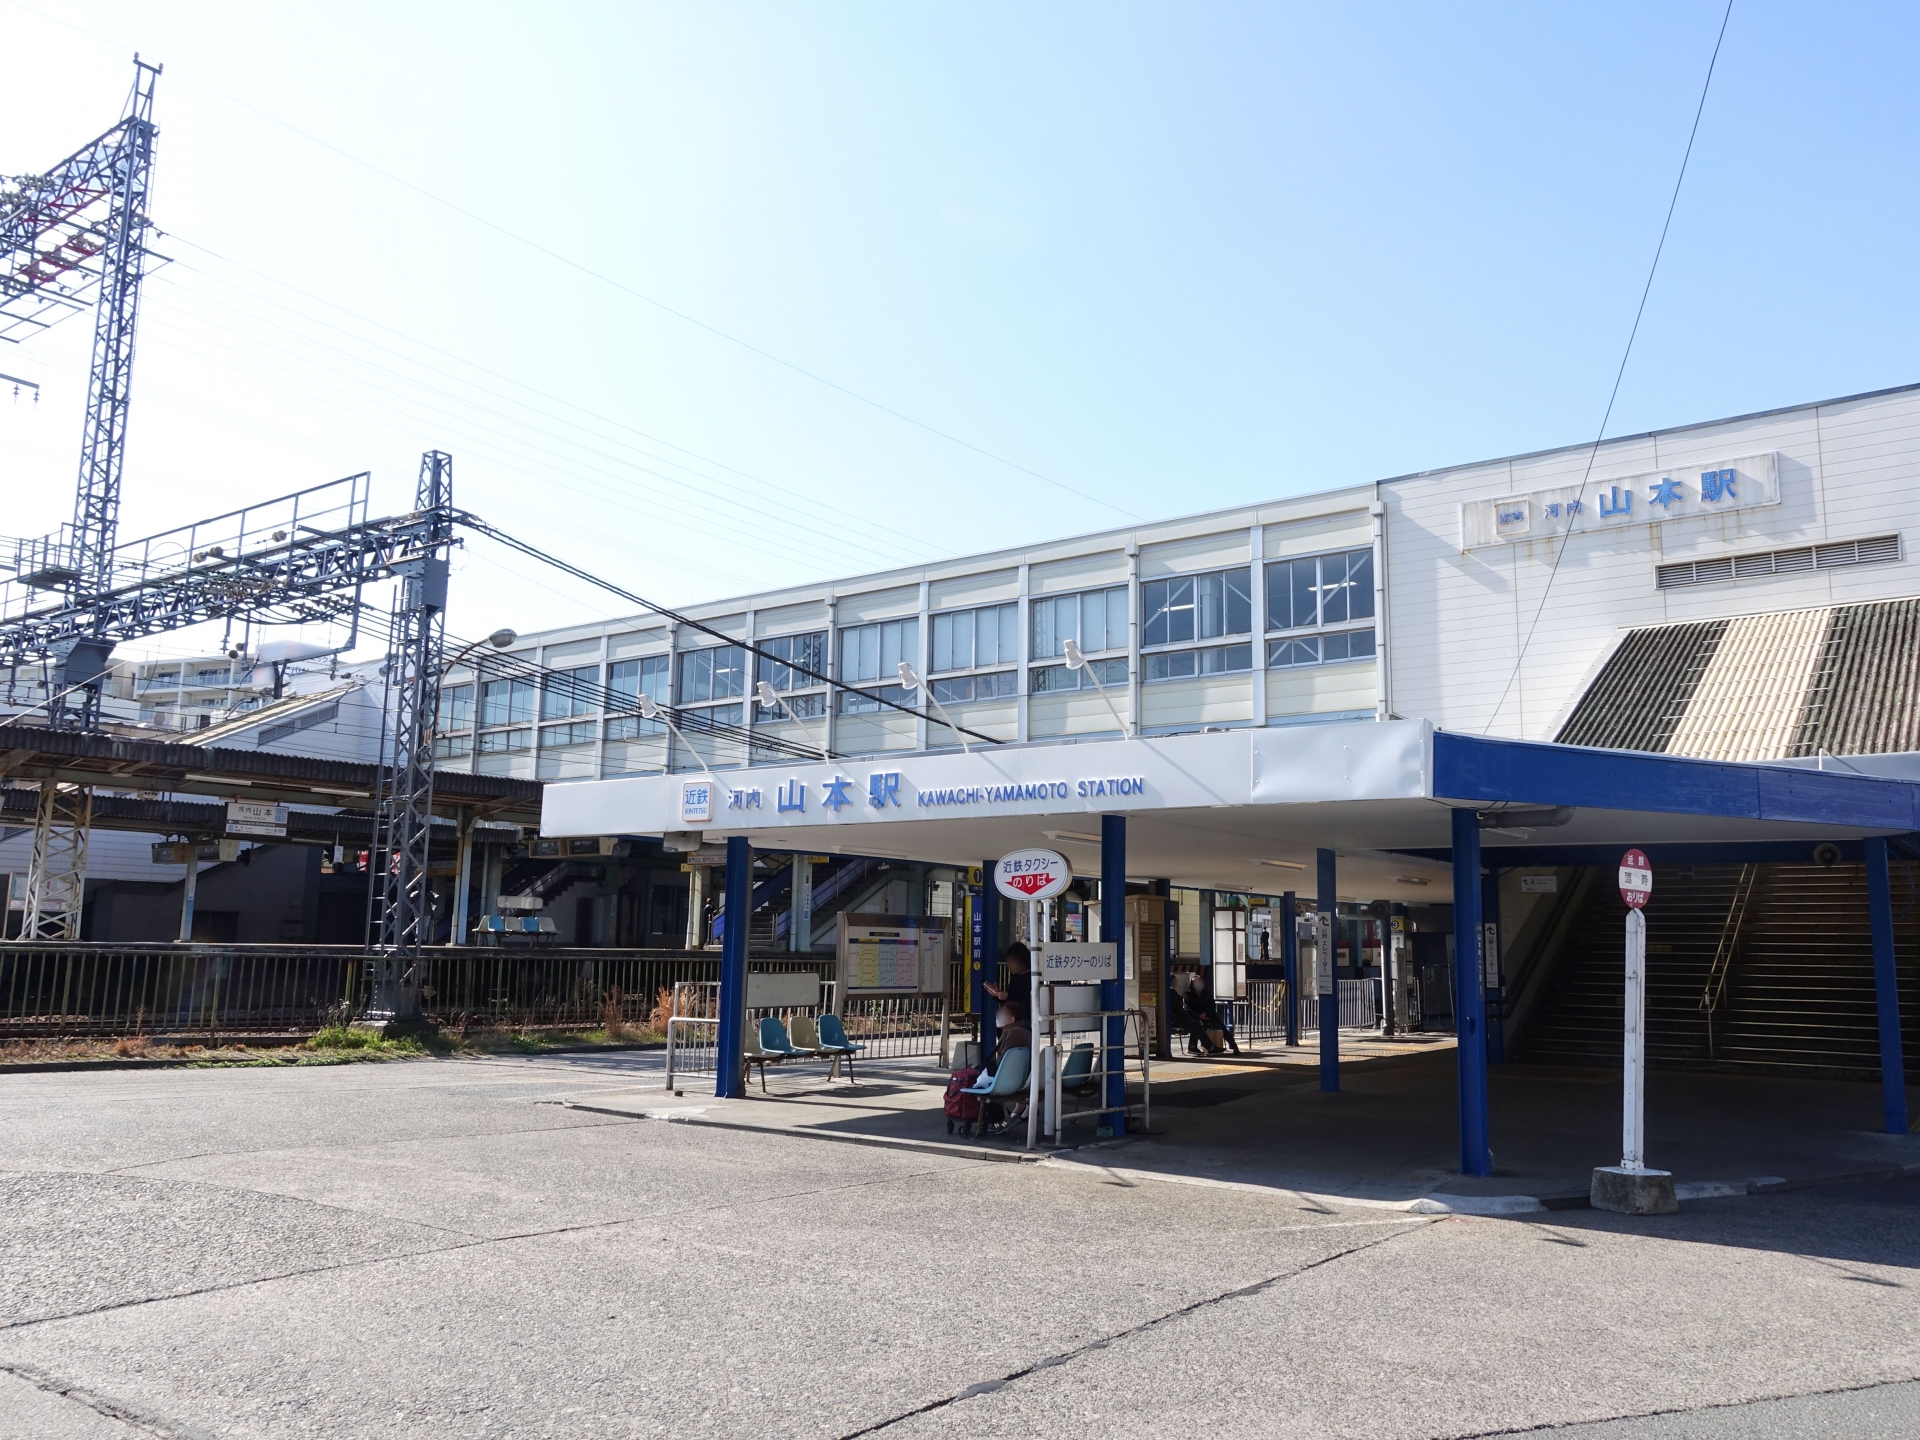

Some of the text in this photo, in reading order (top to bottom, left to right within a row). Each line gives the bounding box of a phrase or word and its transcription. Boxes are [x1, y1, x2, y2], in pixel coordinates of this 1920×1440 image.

[1544, 468, 1737, 519] 河内山本駅
[685, 788, 708, 805] 近鉄
[728, 772, 902, 813] 河内山本駅
[917, 777, 1144, 807] KAWACHI-YAMAMOTO STATION
[685, 807, 707, 815] KINTETSU
[1003, 858, 1059, 874] 近鉄タクシー
[1627, 854, 1644, 866] 近鉄
[1013, 873, 1047, 887] のりば
[1624, 871, 1648, 887] 臨時
[1626, 892, 1644, 904] おりば
[973, 911, 982, 958] 山本駅前
[1046, 955, 1112, 969] 近鉄タクシーのりば
